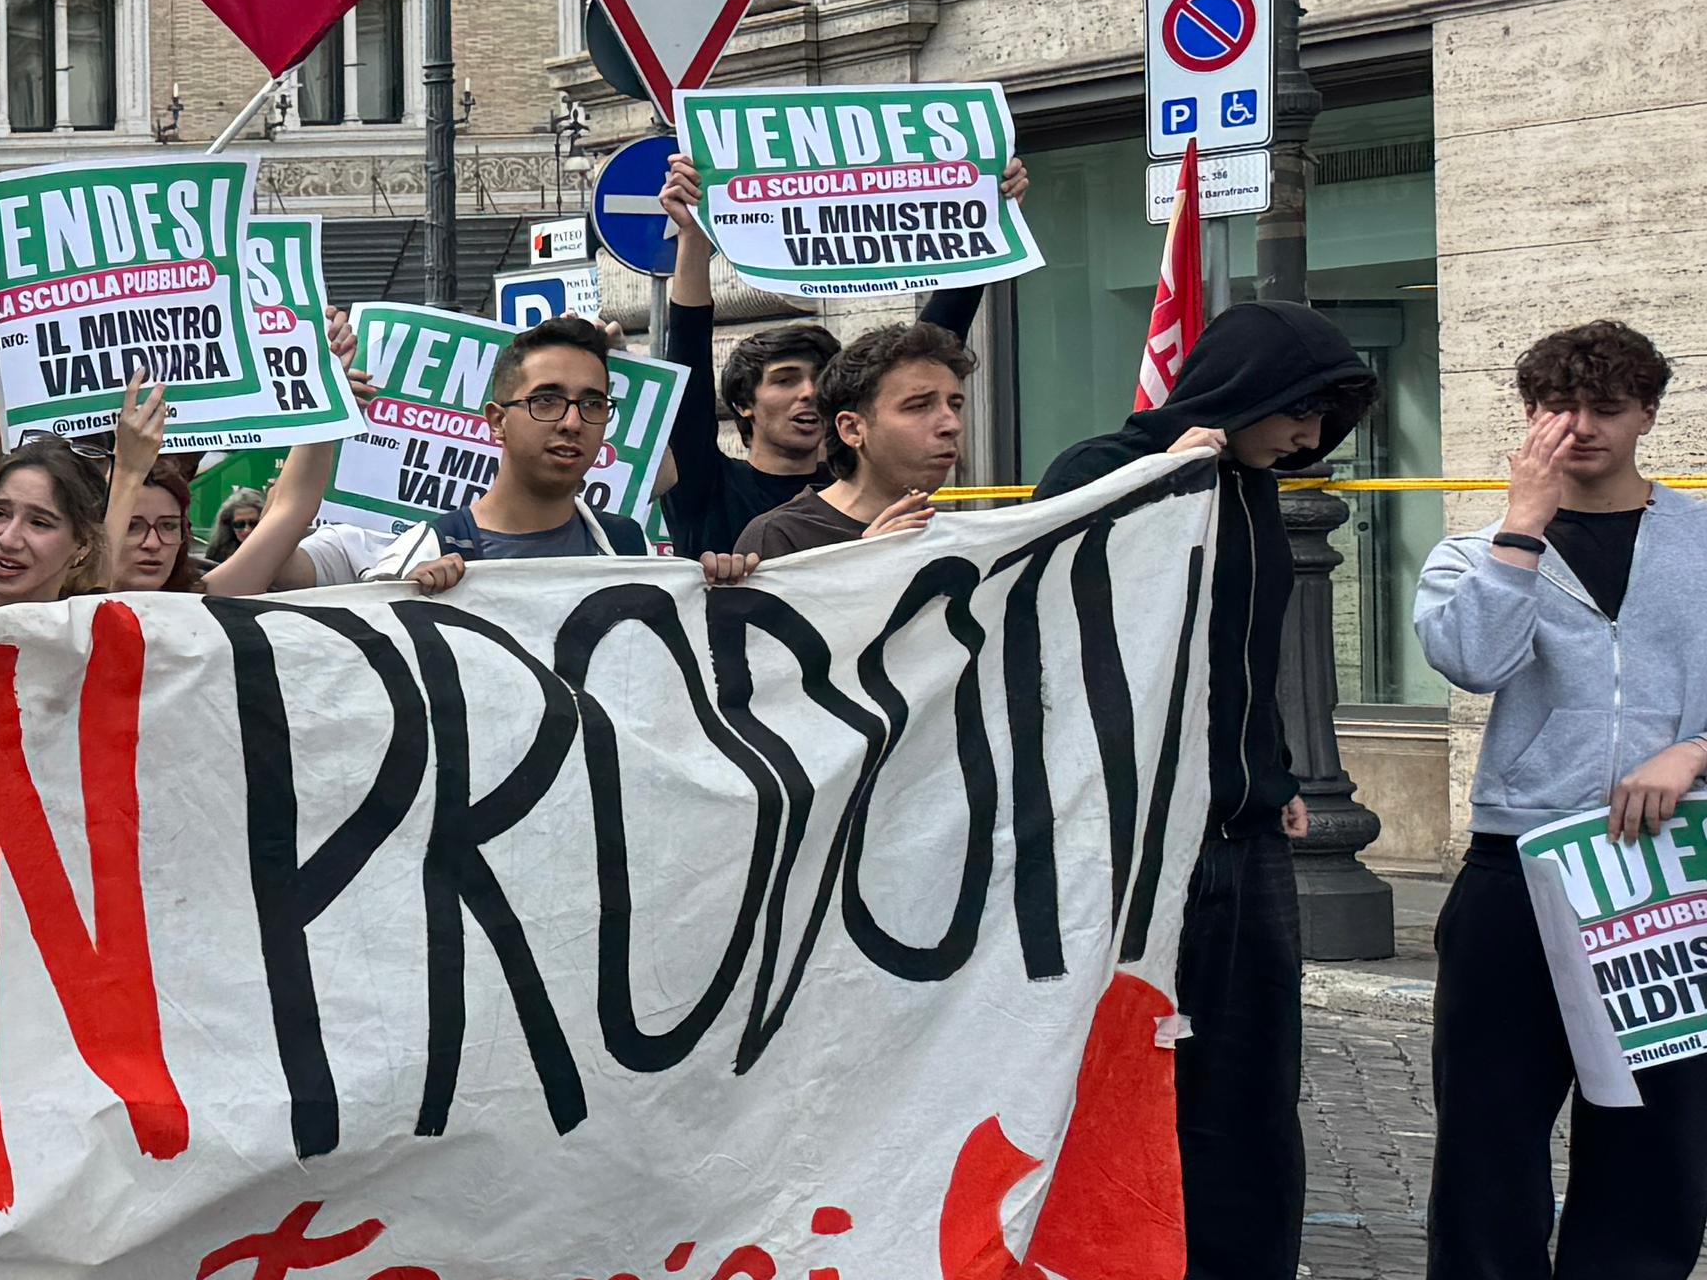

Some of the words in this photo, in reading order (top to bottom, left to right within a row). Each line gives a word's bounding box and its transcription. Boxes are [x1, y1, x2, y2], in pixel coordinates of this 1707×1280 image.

[696, 100, 996, 170] VENDESI
[1170, 104, 1191, 132] P
[734, 180, 763, 200] LA
[768, 173, 858, 198] SCUOLA
[861, 165, 973, 191] PUBBLICA
[1205, 186, 1260, 200] Barrafranca
[713, 214, 738, 226] PER
[741, 213, 775, 225] INFO:
[781, 206, 811, 235] IL
[819, 199, 988, 234] MINISTRO
[784, 231, 998, 267] VALDITARA
[17, 276, 123, 314] SCUOLA
[122, 263, 212, 295] PUBBLICA
[35, 320, 71, 358] IL
[79, 304, 222, 350] MINISTRO
[39, 341, 231, 398] VALDITARA
[373, 401, 399, 423] LA
[401, 407, 491, 442] SCUOLA
[402, 437, 429, 471] IL
